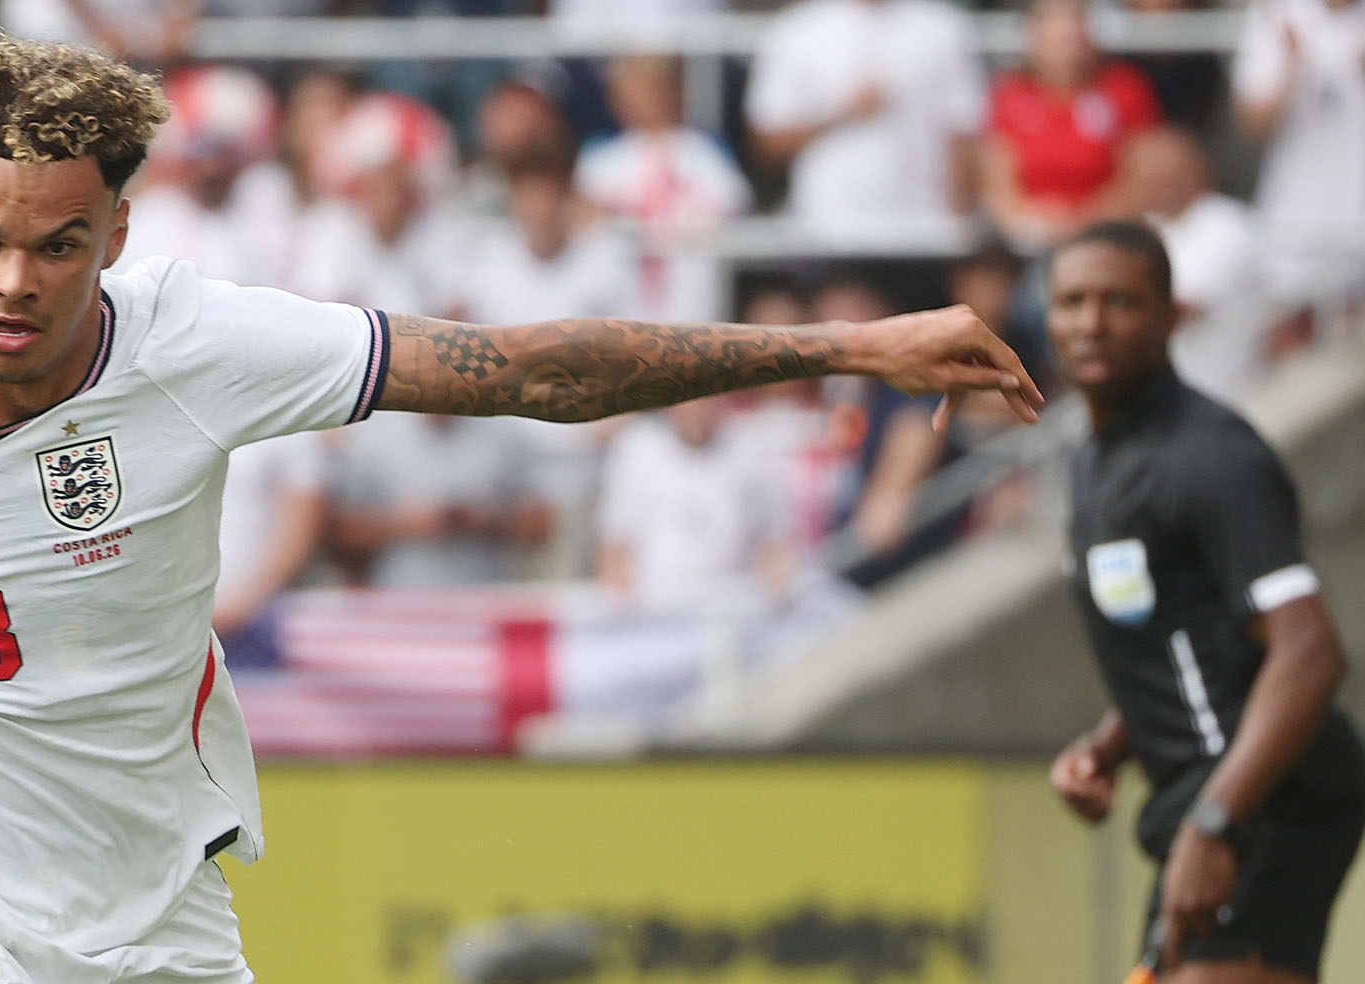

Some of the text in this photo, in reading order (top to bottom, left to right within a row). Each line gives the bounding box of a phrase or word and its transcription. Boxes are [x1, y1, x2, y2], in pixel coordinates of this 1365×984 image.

[53, 526, 133, 554] COSTA RICA
[73, 544, 121, 567] 10.06.26
